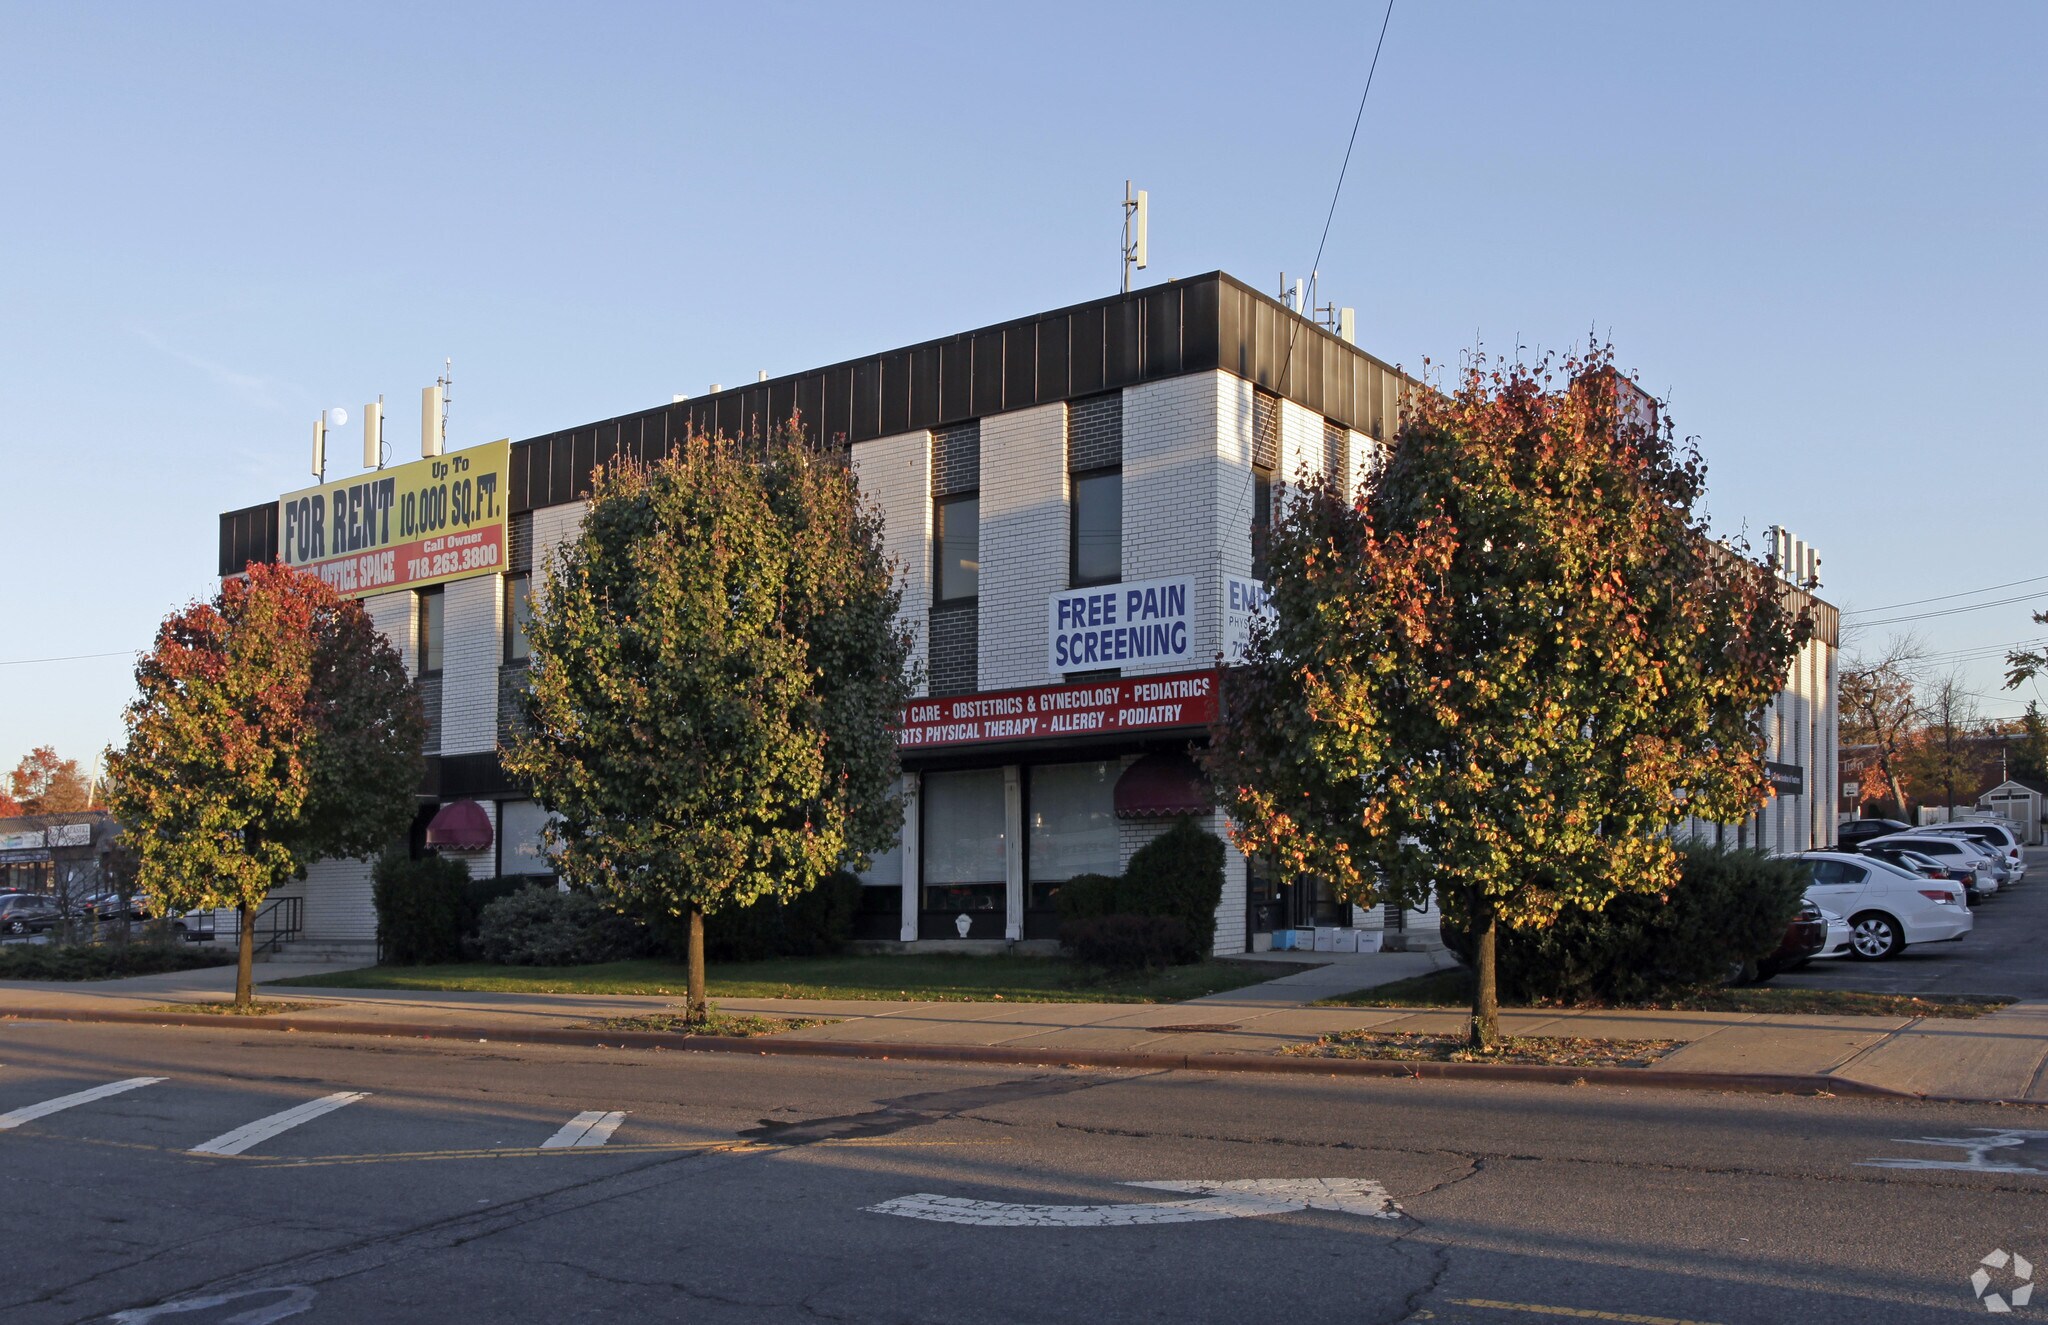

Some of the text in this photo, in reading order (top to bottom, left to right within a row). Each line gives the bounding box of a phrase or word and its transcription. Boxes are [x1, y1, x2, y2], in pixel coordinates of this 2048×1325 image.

[432, 456, 469, 481] Up To
[284, 477, 395, 564] FOR RENT
[400, 472, 500, 540] 10,000 SQ.FT.
[407, 543, 498, 580] 718.263.3800
[423, 532, 483, 553] Call Owner
[321, 551, 395, 593] OFFICE SPACE
[1058, 584, 1186, 630] FREE PAIN
[1056, 621, 1187, 667] SCREENING
[901, 709, 907, 723] Y
[911, 705, 941, 723] CARE
[952, 697, 1023, 719] OBSTETRICS
[1027, 695, 1036, 712] &
[1040, 687, 1120, 711] GYNECOLOGY
[1134, 677, 1210, 702] PEDIATRICS
[897, 727, 922, 745] RTS
[926, 722, 980, 742] PHYSICAL
[984, 717, 1038, 737] THERAPY
[1050, 711, 1105, 732] ALLERGY
[1118, 704, 1182, 726] PODIATRY
